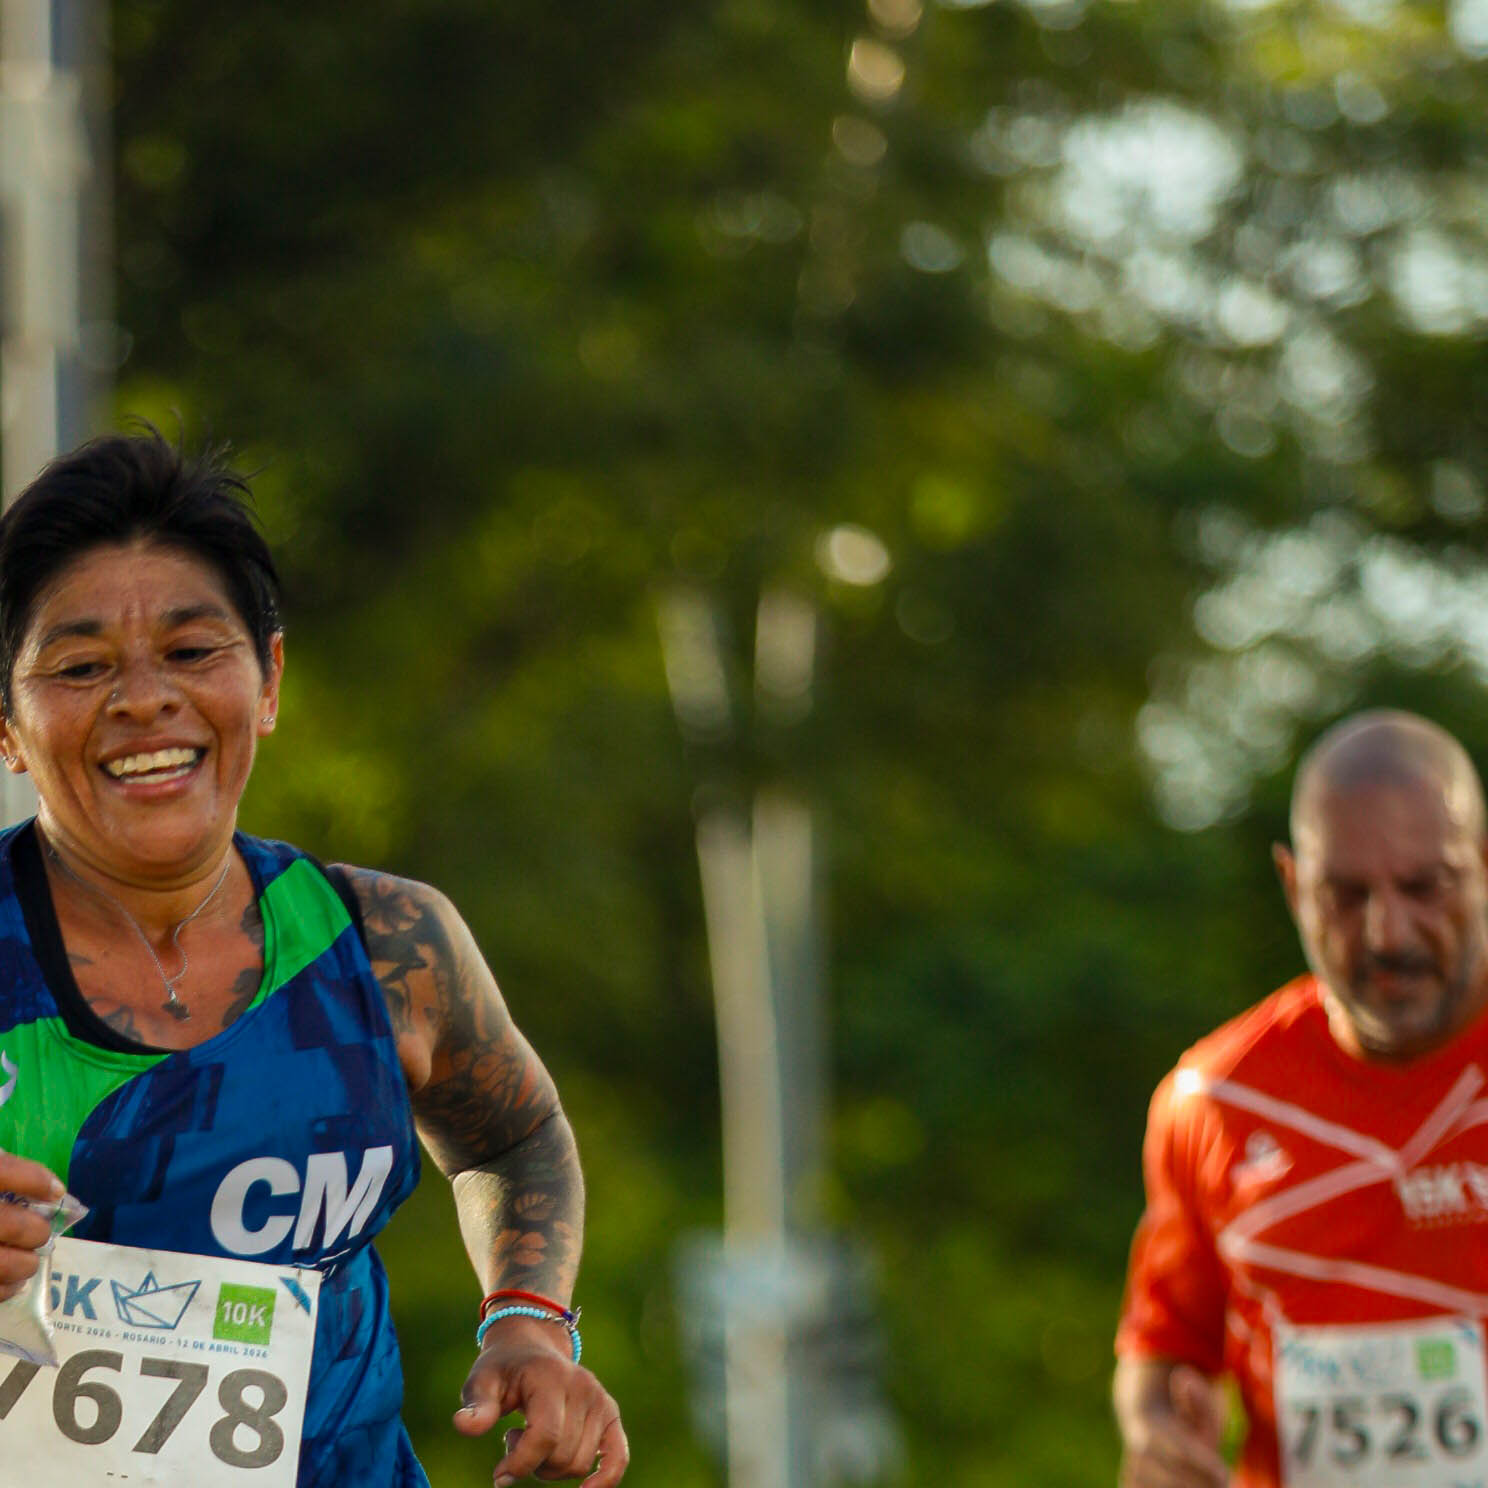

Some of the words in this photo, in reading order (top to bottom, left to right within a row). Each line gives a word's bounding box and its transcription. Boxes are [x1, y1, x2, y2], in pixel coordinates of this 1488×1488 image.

[210, 1144, 393, 1256] CM
[86, 1326, 112, 1338] 2026
[122, 1331, 167, 1345] ROSARIO
[177, 1338, 189, 1348] 12
[193, 1340, 205, 1351] DE
[209, 1343, 239, 1355] ABRIL
[242, 1347, 268, 1359] 2026
[223, 1301, 268, 1328] 10K
[1291, 1385, 1480, 1467] 7526
